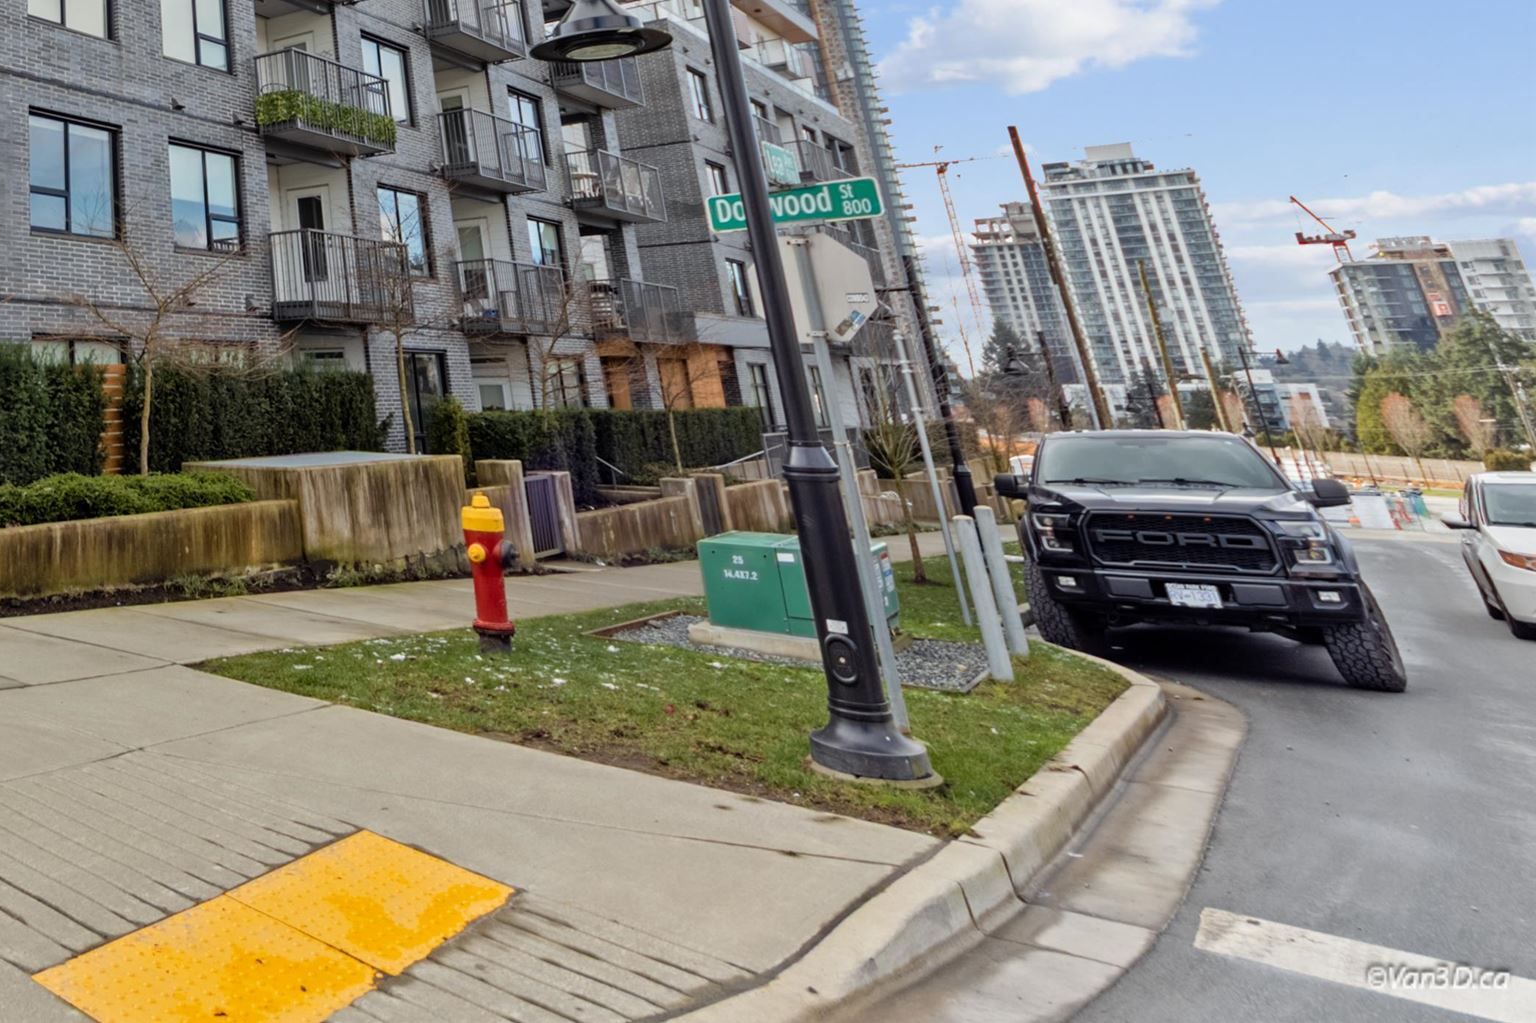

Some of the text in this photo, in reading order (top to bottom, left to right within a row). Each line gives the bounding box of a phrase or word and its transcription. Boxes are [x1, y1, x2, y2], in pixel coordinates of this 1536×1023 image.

[715, 183, 854, 224] Dowood St
[842, 198, 872, 216] 800
[1094, 529, 1270, 551] FORD
